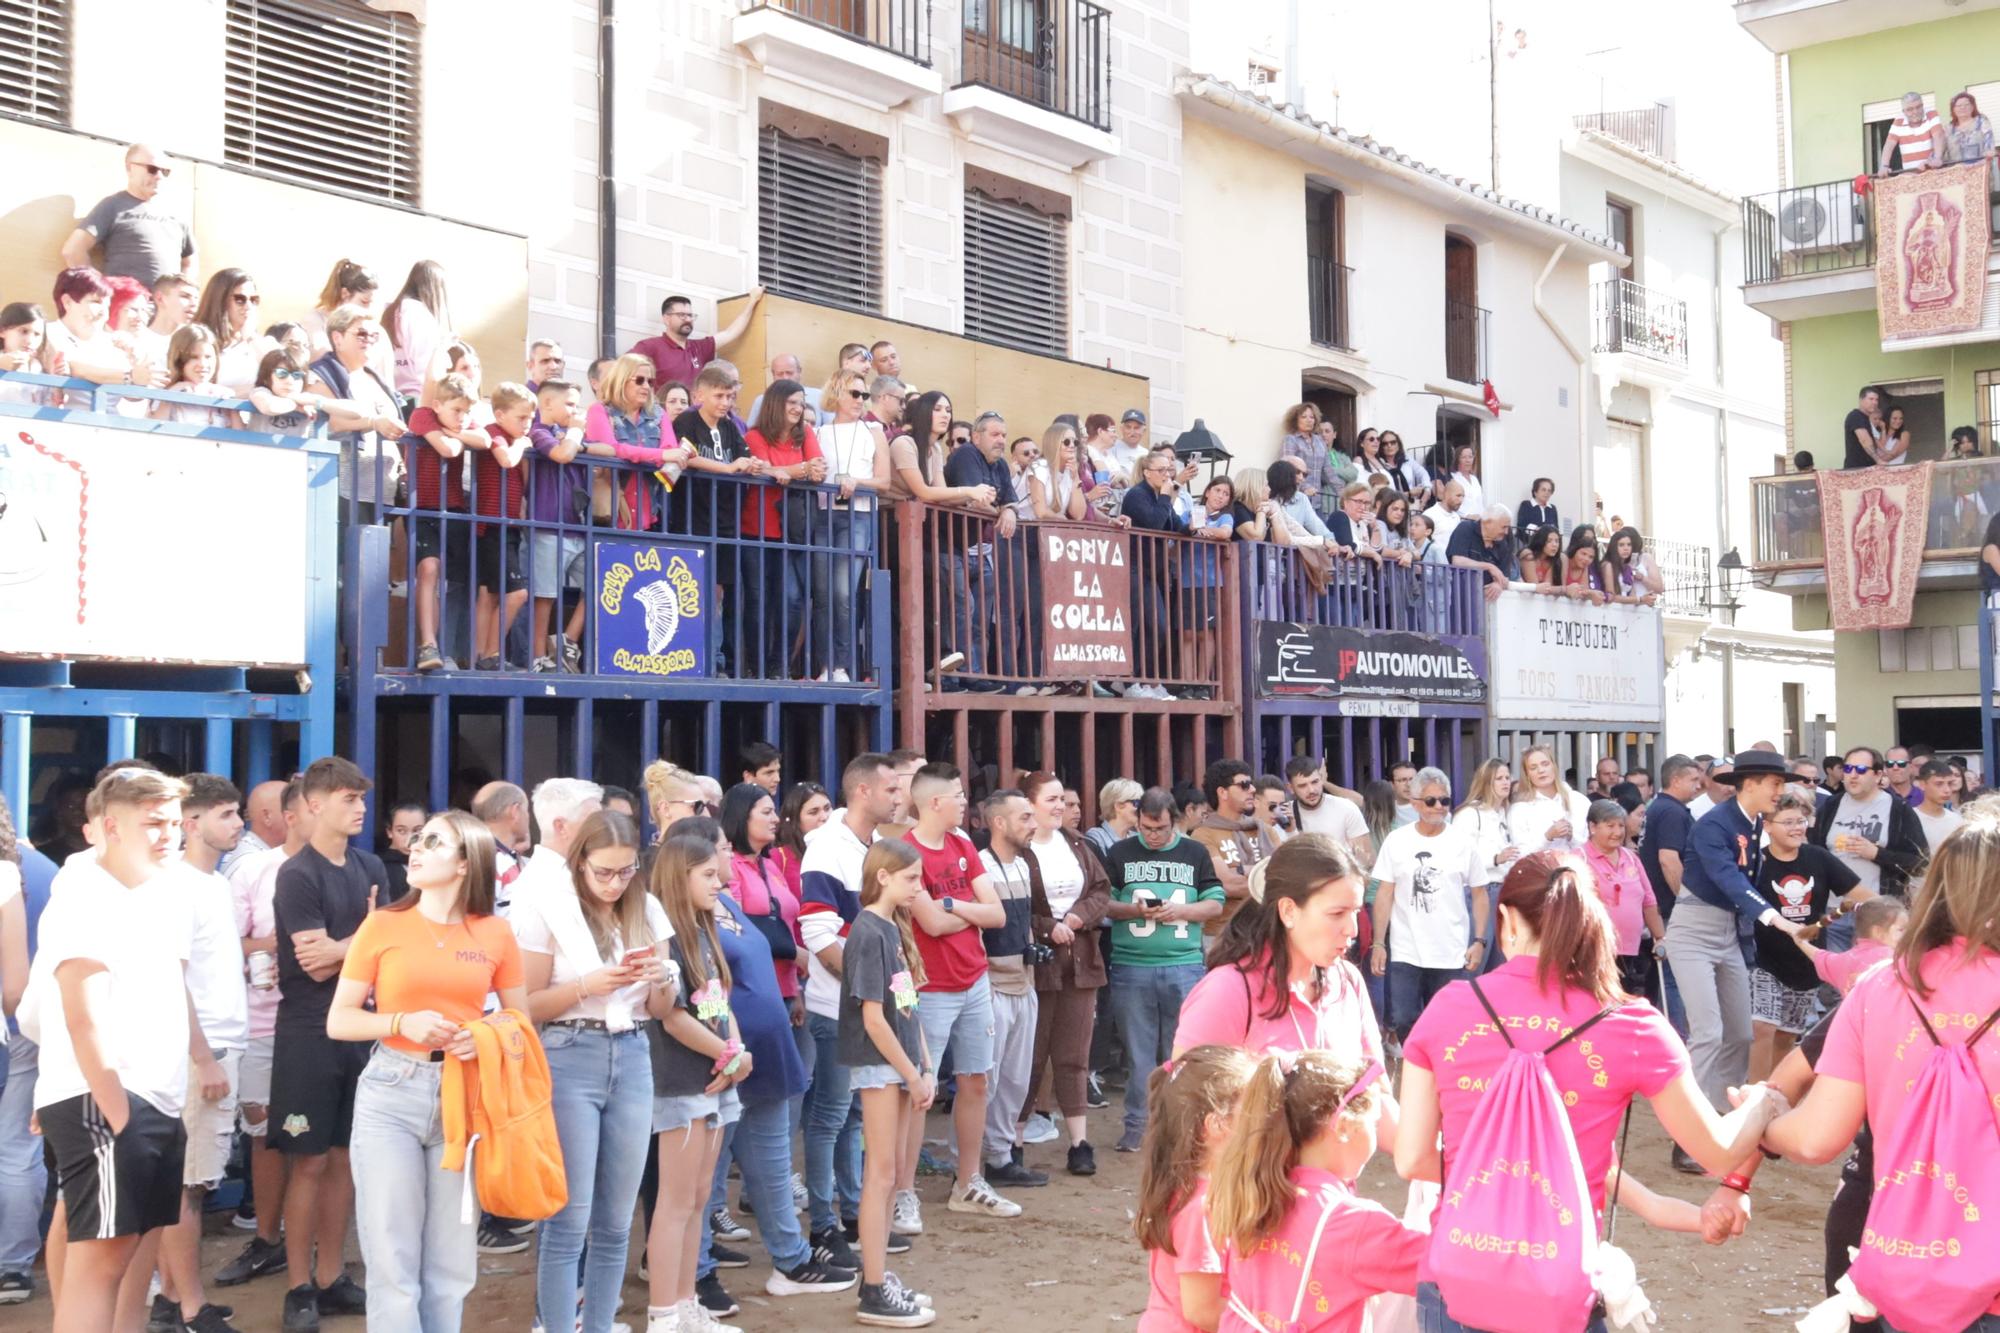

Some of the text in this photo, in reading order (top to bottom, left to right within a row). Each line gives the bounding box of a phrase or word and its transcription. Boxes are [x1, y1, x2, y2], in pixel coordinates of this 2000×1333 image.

[600, 562, 634, 616] COLLA
[634, 547, 662, 572] LA
[1073, 570, 1103, 598] LA
[1050, 603, 1126, 631] COLLA
[1539, 618, 1618, 650] T'EMPUJEN
[612, 647, 696, 676] ALMASSORA
[1053, 643, 1126, 662] ALMASSORA
[1518, 668, 1557, 698] TOTS
[1124, 861, 1194, 886] BOSTON
